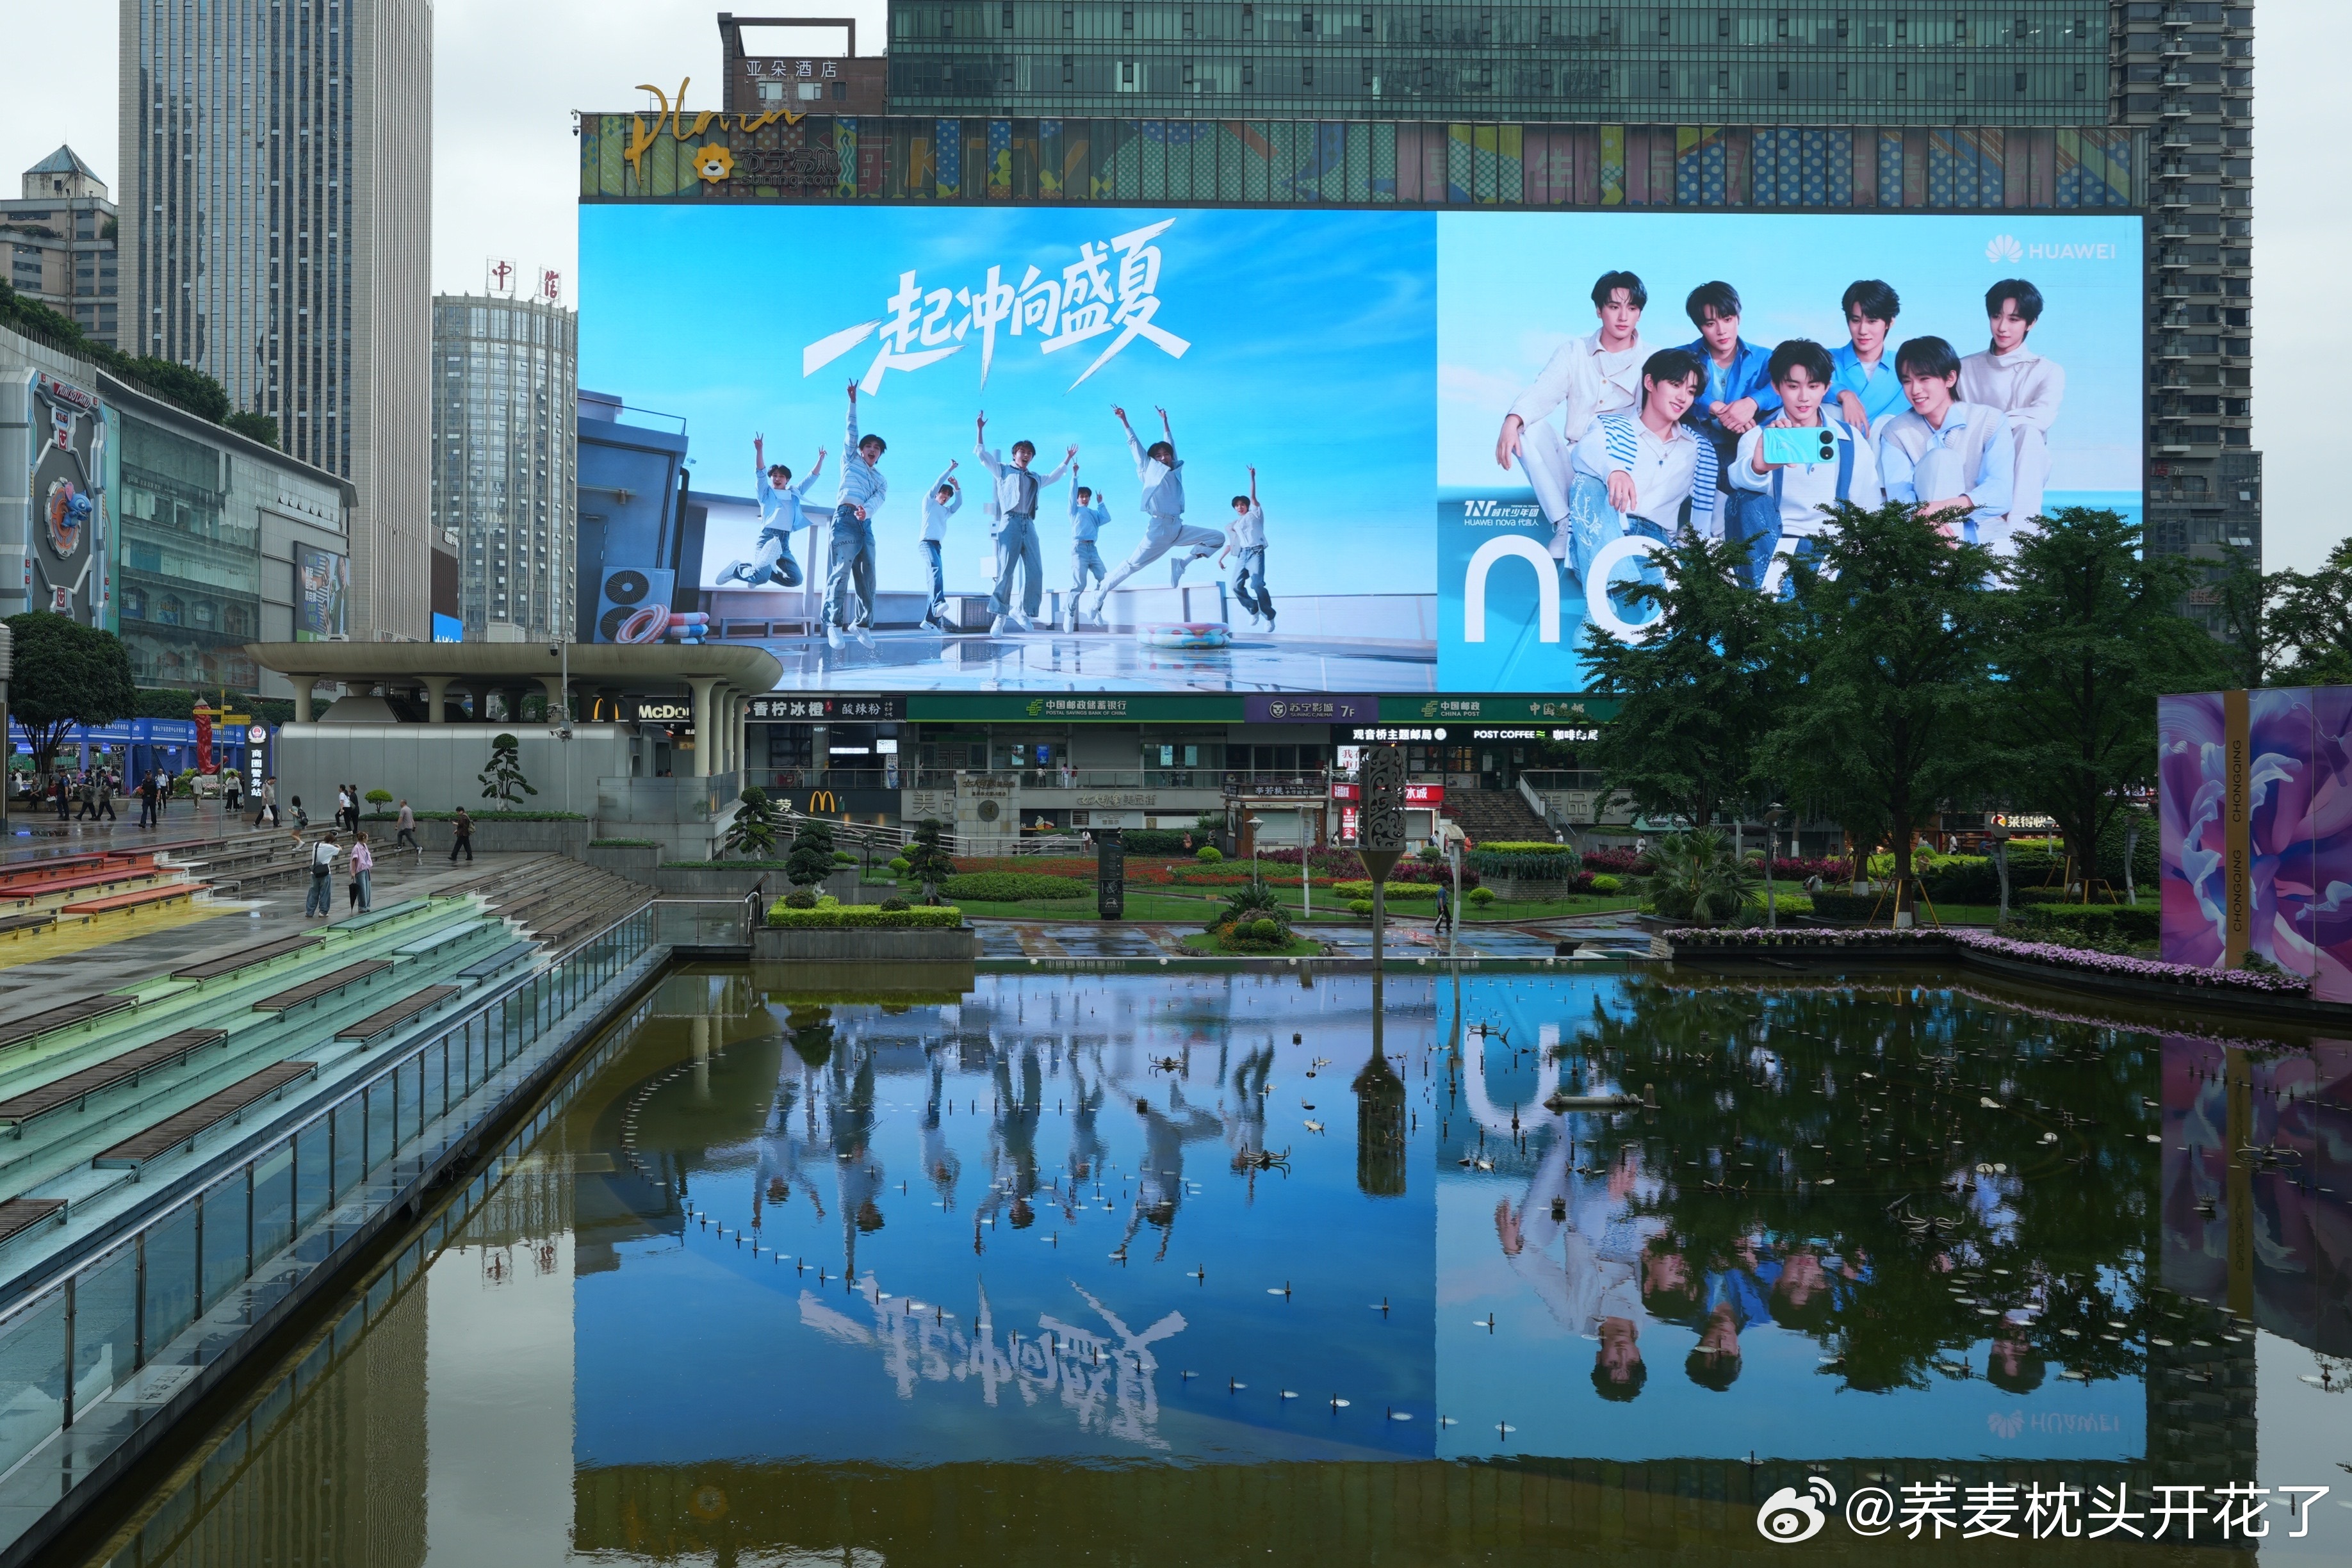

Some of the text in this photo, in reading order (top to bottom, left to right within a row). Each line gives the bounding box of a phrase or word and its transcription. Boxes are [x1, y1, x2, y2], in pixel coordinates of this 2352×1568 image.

[746, 60, 838, 78] 亚朵酒店
[740, 147, 840, 173] 苏宁易购
[741, 174, 840, 190] suning.com
[2029, 243, 2116, 260] HUAWEI
[491, 259, 560, 299] 中信
[802, 216, 1191, 396] 一起冲向盛夏
[1490, 508, 1540, 517] 时代少年团
[1517, 518, 1539, 527] 代言人
[753, 701, 824, 717] 香柠冰橙
[842, 703, 881, 716] 酸辣粉
[1045, 699, 1127, 711] 中国邮政储蓄银行
[1289, 703, 1355, 717] 苏宁影城 7F
[1440, 701, 1480, 711] 中国邮政
[1353, 729, 1432, 740] 观音桥主题邮局
[1474, 730, 1535, 739] POST COFFEE
[250, 749, 263, 797] 商圈警务站
[2233, 739, 2242, 823] CHONGQING
[1255, 786, 1284, 795] 李若桃
[2007, 815, 2060, 828] 莱得快
[2233, 849, 2242, 933] CHONGQING
